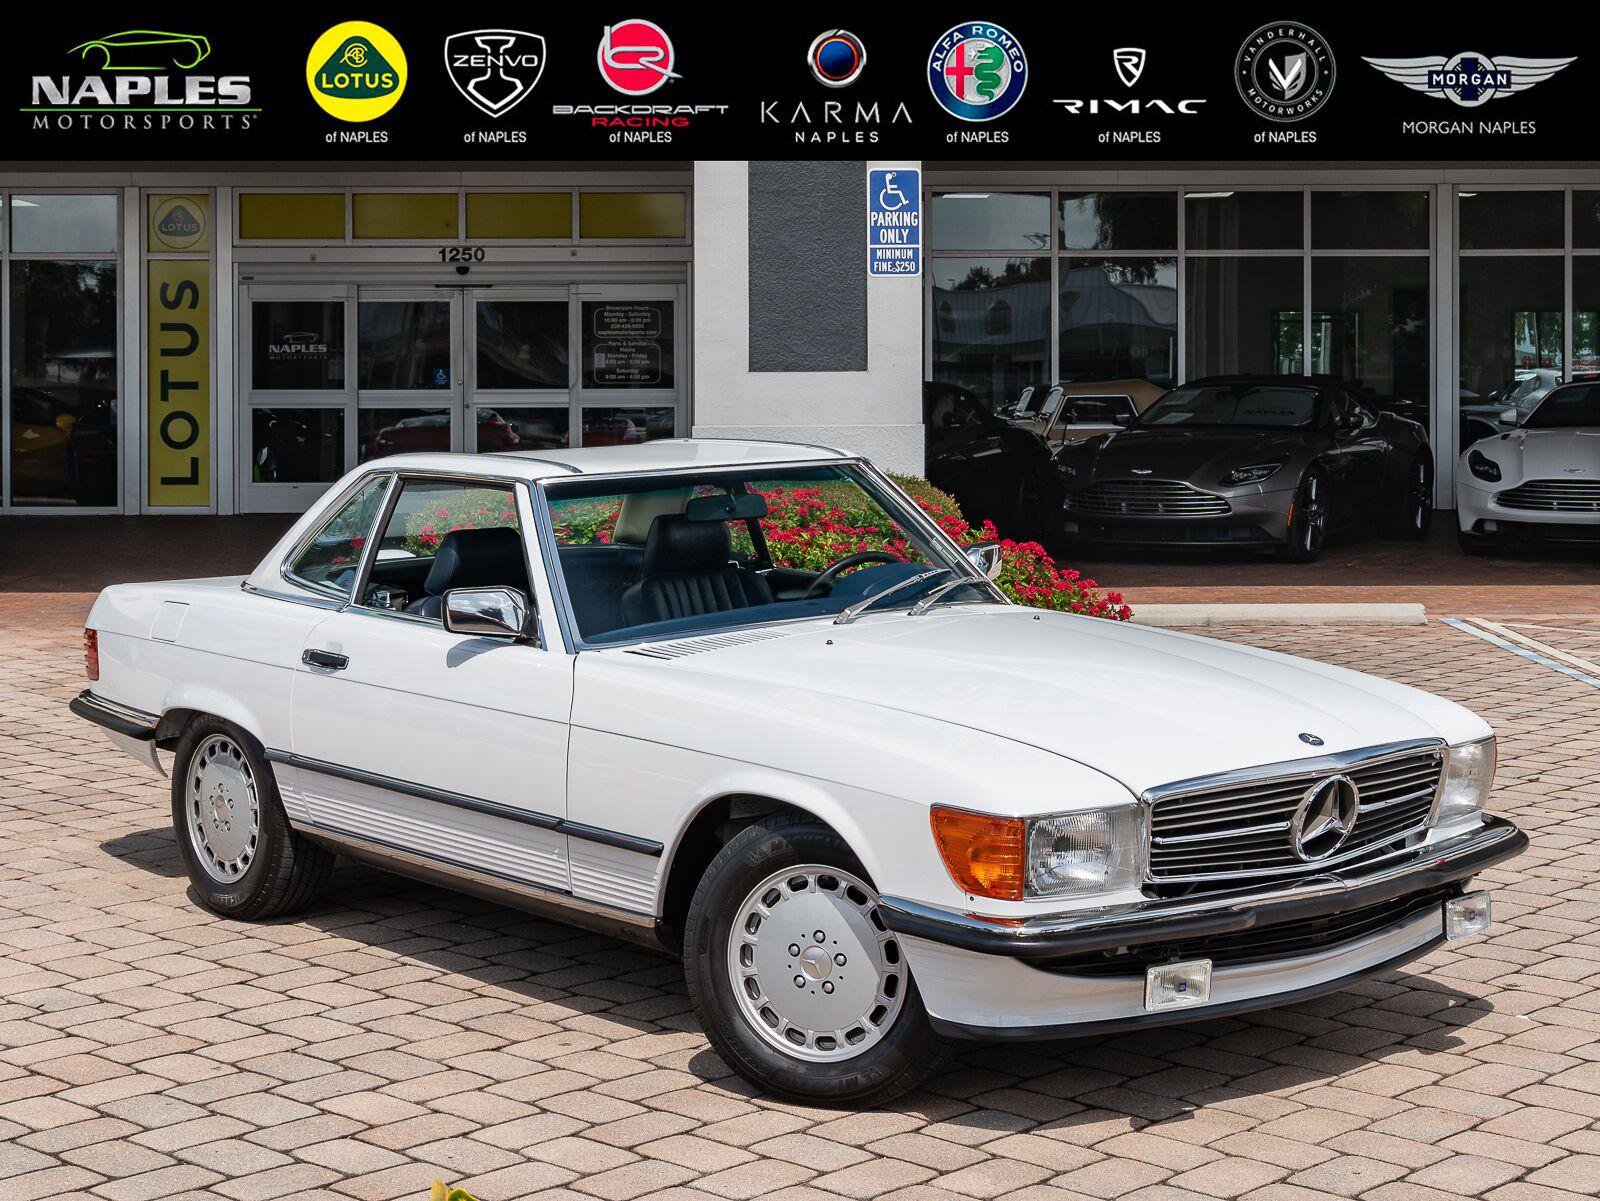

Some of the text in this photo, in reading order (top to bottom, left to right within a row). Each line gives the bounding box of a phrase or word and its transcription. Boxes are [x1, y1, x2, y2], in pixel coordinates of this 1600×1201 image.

[871, 211, 919, 227] PARKING
[162, 223, 198, 232] LOTUS
[880, 228, 909, 244] ONLY
[439, 247, 486, 262] 1250
[876, 249, 913, 259] MINIMUM
[874, 261, 916, 273] FINE $250
[269, 344, 328, 353] NAPLES
[160, 280, 199, 485] LOTUS
